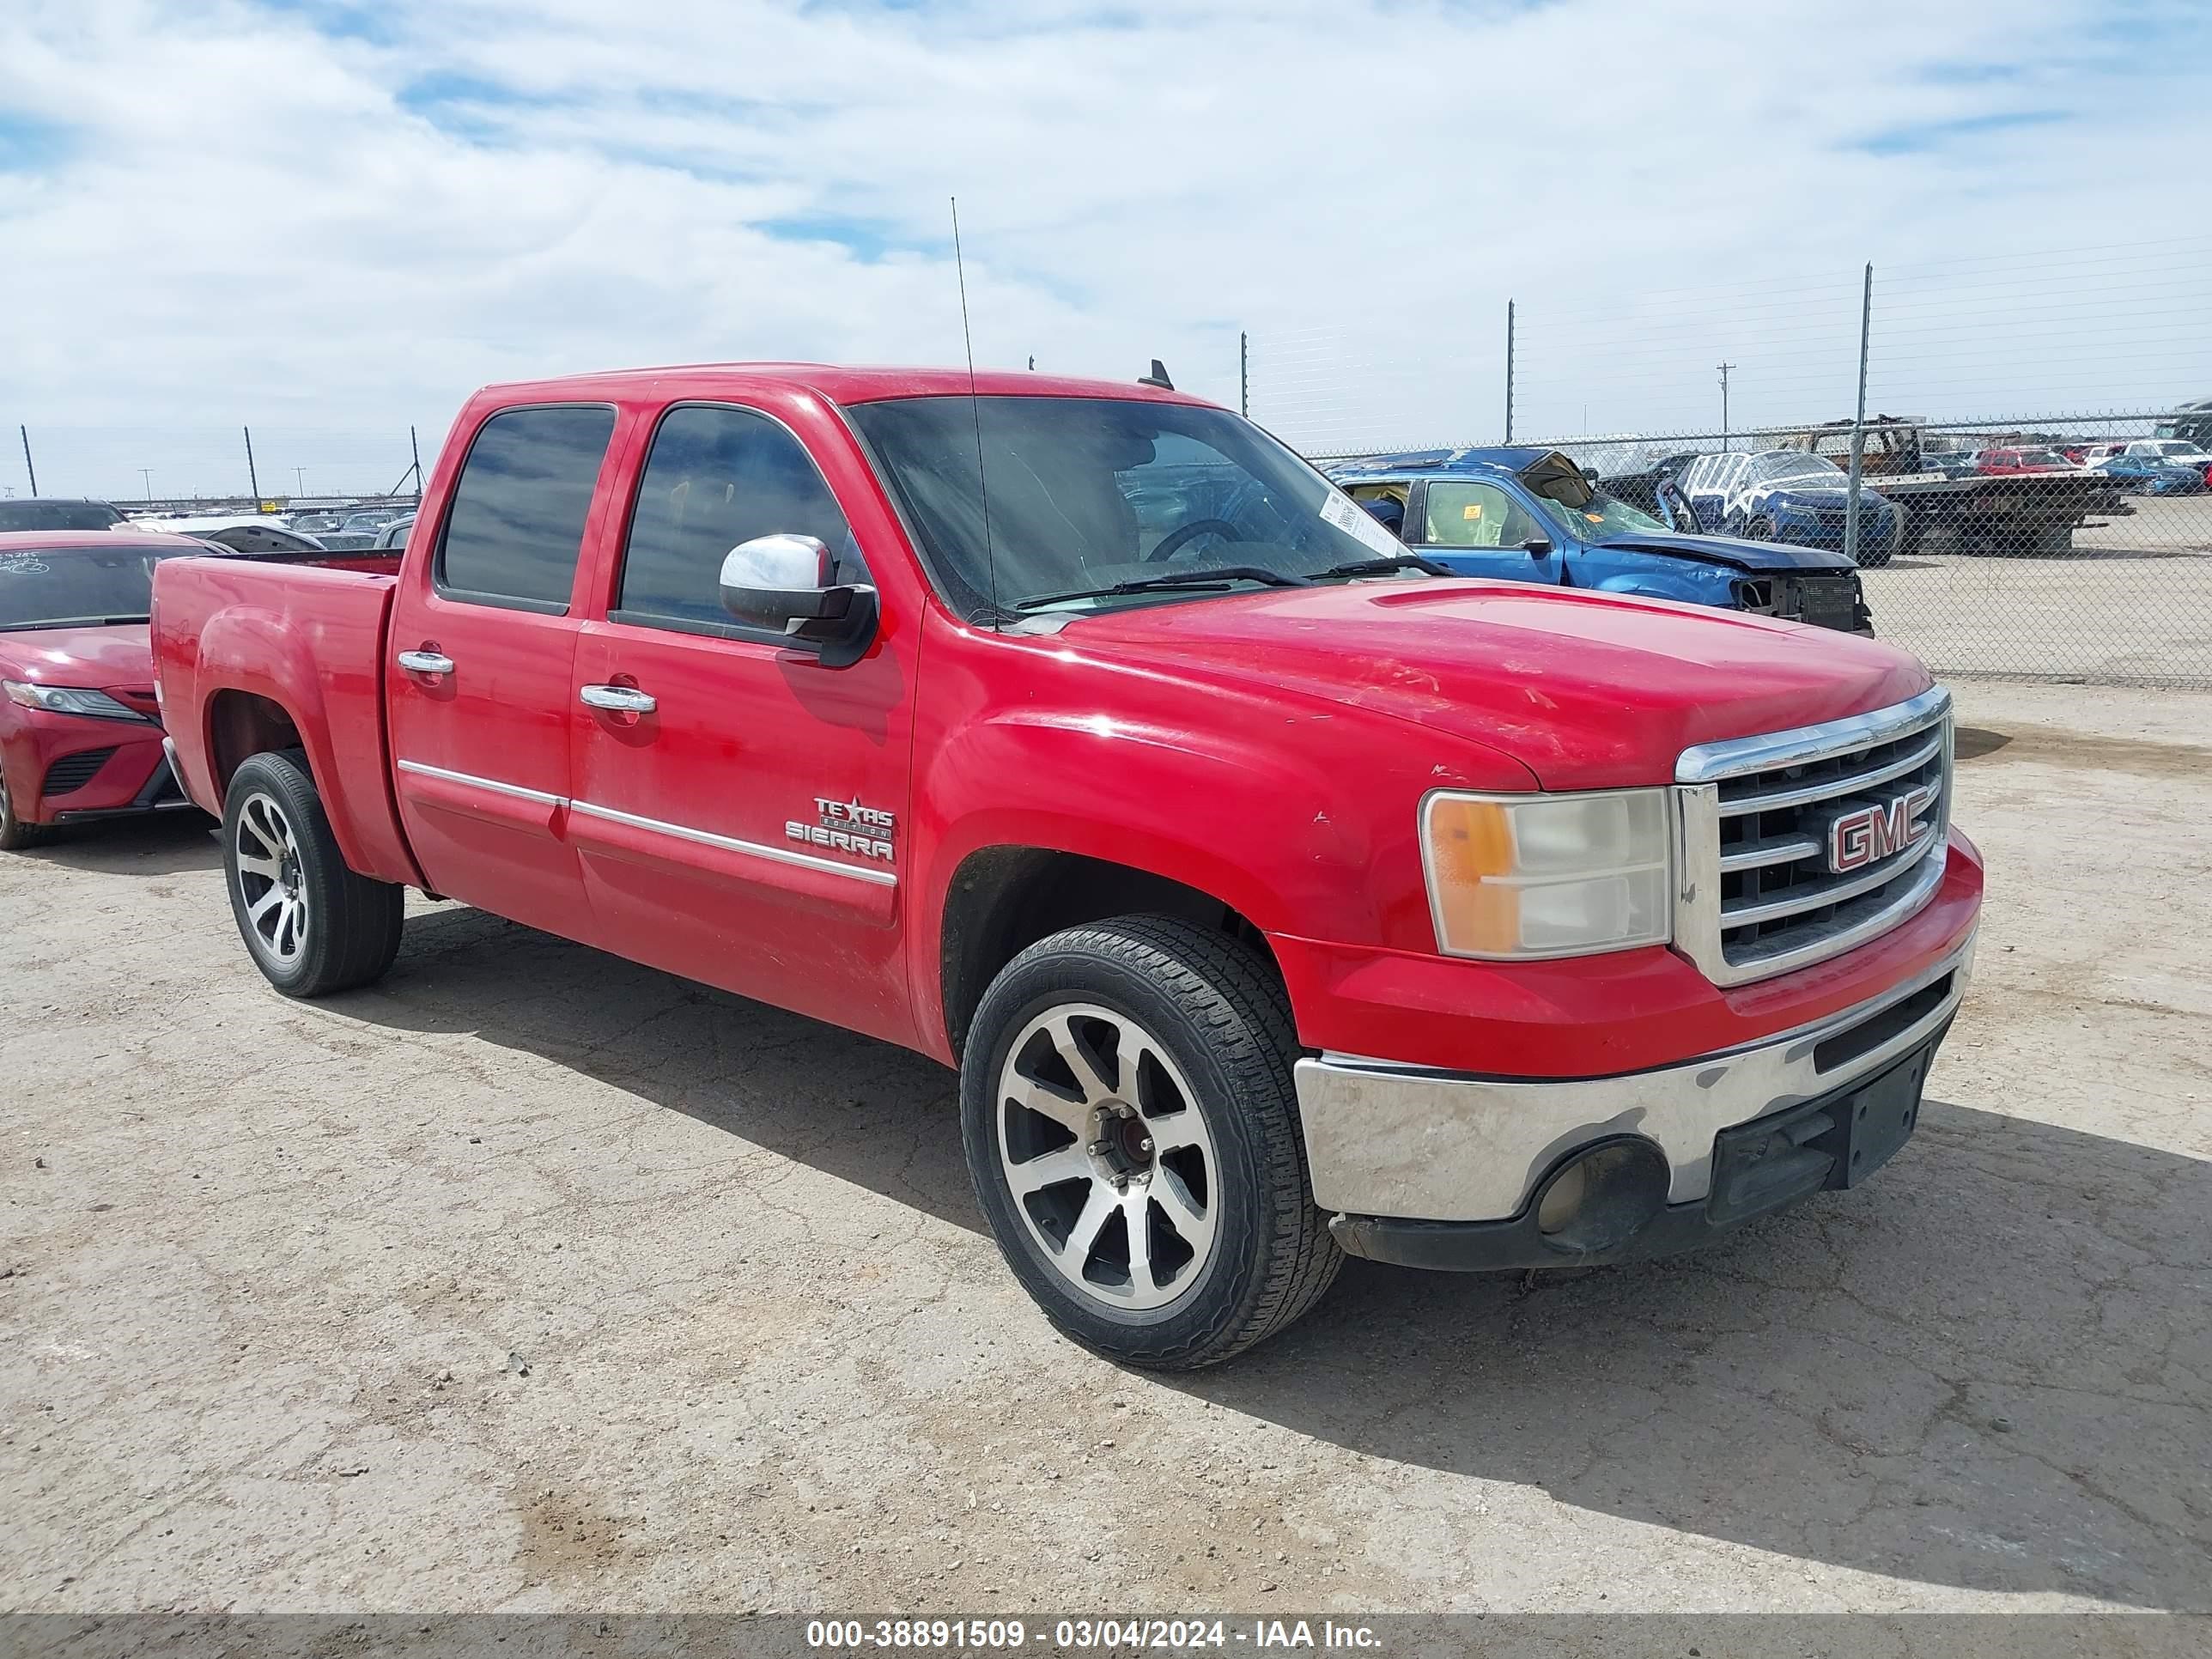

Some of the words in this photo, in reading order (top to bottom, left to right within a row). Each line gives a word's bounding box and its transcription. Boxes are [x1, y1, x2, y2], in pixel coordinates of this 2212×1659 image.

[813, 796, 895, 827] TEXAS
[822, 817, 890, 838] EDITION
[785, 821, 893, 860] SIERRA
[1832, 786, 1929, 873] GMC
